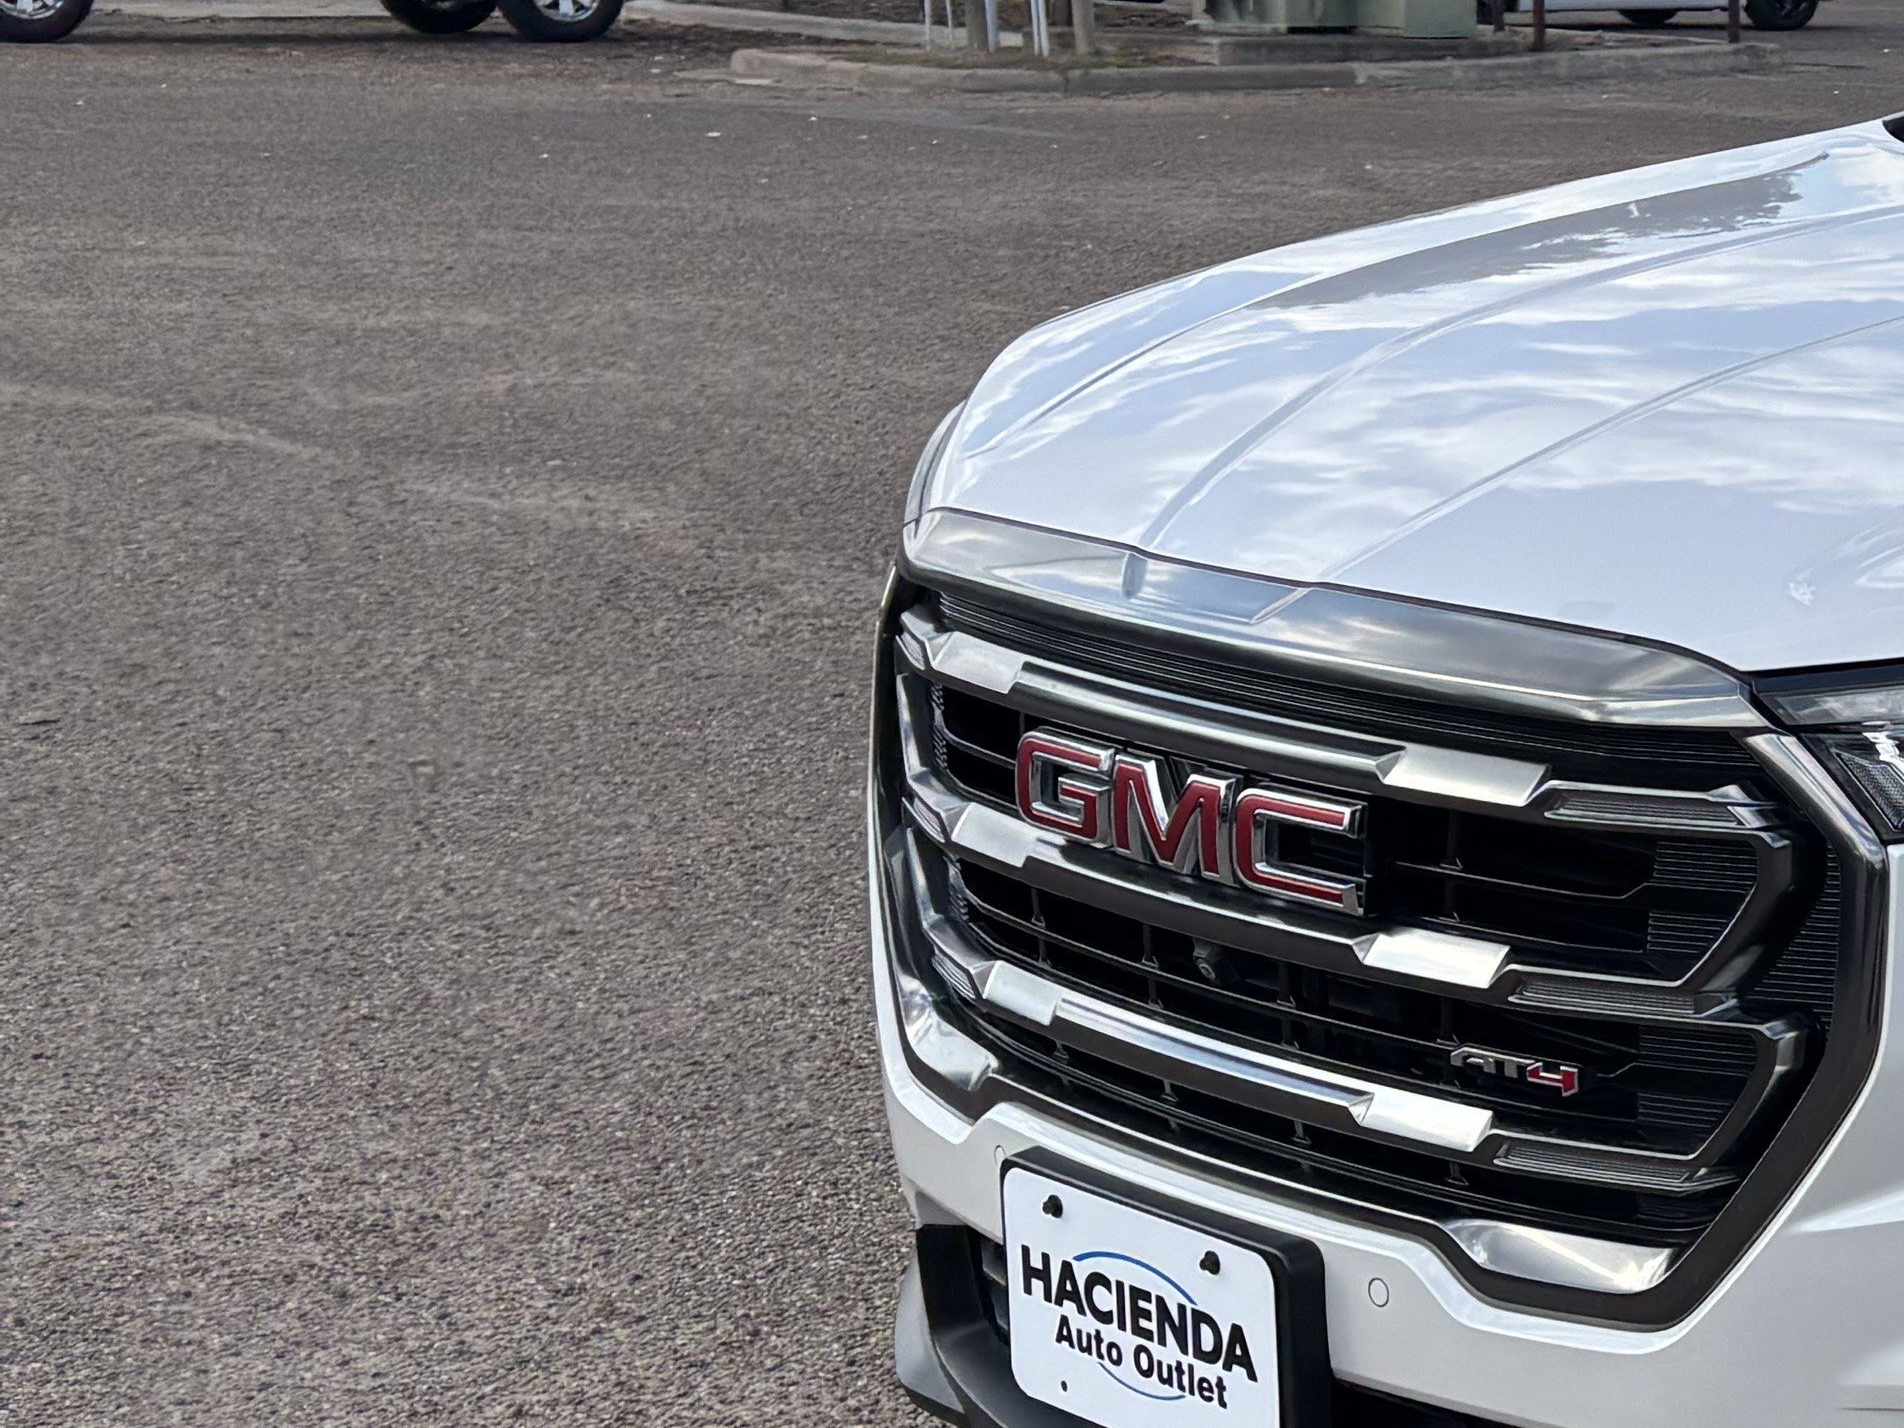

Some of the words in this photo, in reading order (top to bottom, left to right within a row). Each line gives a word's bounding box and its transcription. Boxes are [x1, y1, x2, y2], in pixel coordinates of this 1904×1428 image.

[1016, 729, 1367, 917] GMC
[1450, 1045, 1580, 1098] AT4
[1020, 1244, 1260, 1383] HACIENDA
[1055, 1315, 1124, 1368] Auto
[1132, 1343, 1229, 1410] Outlet
